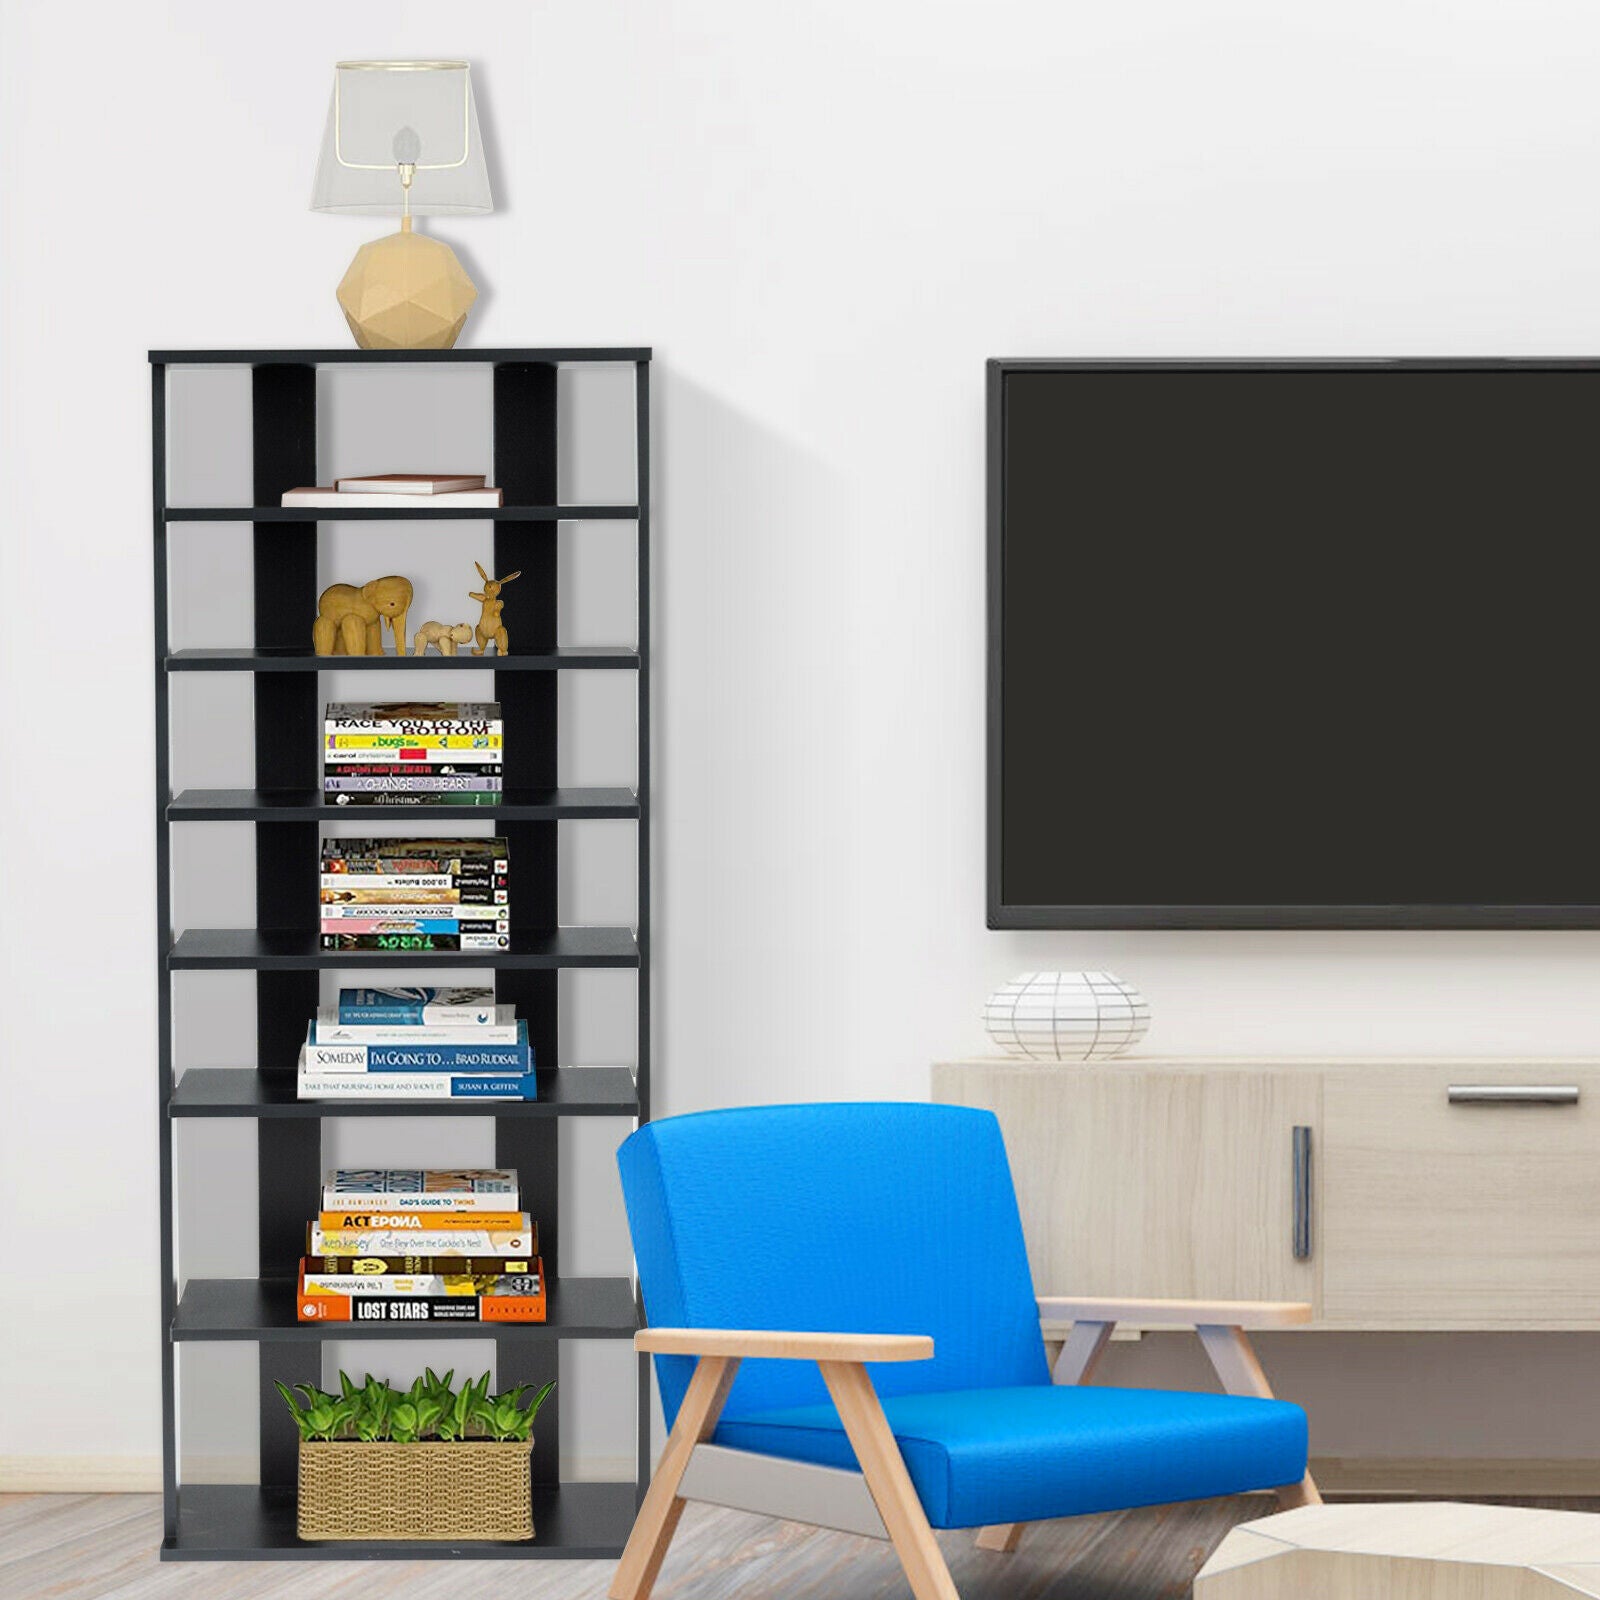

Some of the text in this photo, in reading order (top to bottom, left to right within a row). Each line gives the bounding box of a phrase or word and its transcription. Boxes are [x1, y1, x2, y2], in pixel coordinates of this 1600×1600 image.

[335, 720, 493, 728] RACE YOU TO THE
[402, 727, 488, 735] BOTTOM
[365, 778, 413, 790] CHANGE
[433, 778, 472, 790] HEART
[378, 935, 434, 948] TUROK
[317, 1051, 366, 1064] SOMEDAY
[386, 1051, 424, 1065] GOING
[456, 1053, 480, 1064] BRAD
[305, 1083, 321, 1091] TAKE
[322, 1083, 340, 1091] THAT
[341, 1083, 373, 1091] NURSING
[374, 1083, 394, 1091] HOME
[395, 1083, 411, 1091] AND
[458, 1083, 482, 1091] SUSAN
[399, 1198, 475, 1206] DAD'S GUIDE TO TWINS
[380, 1239, 393, 1248] One
[410, 1239, 425, 1248] Over
[426, 1239, 436, 1248] the
[467, 1239, 481, 1248] Nest
[358, 1302, 429, 1319] LOST STARS
